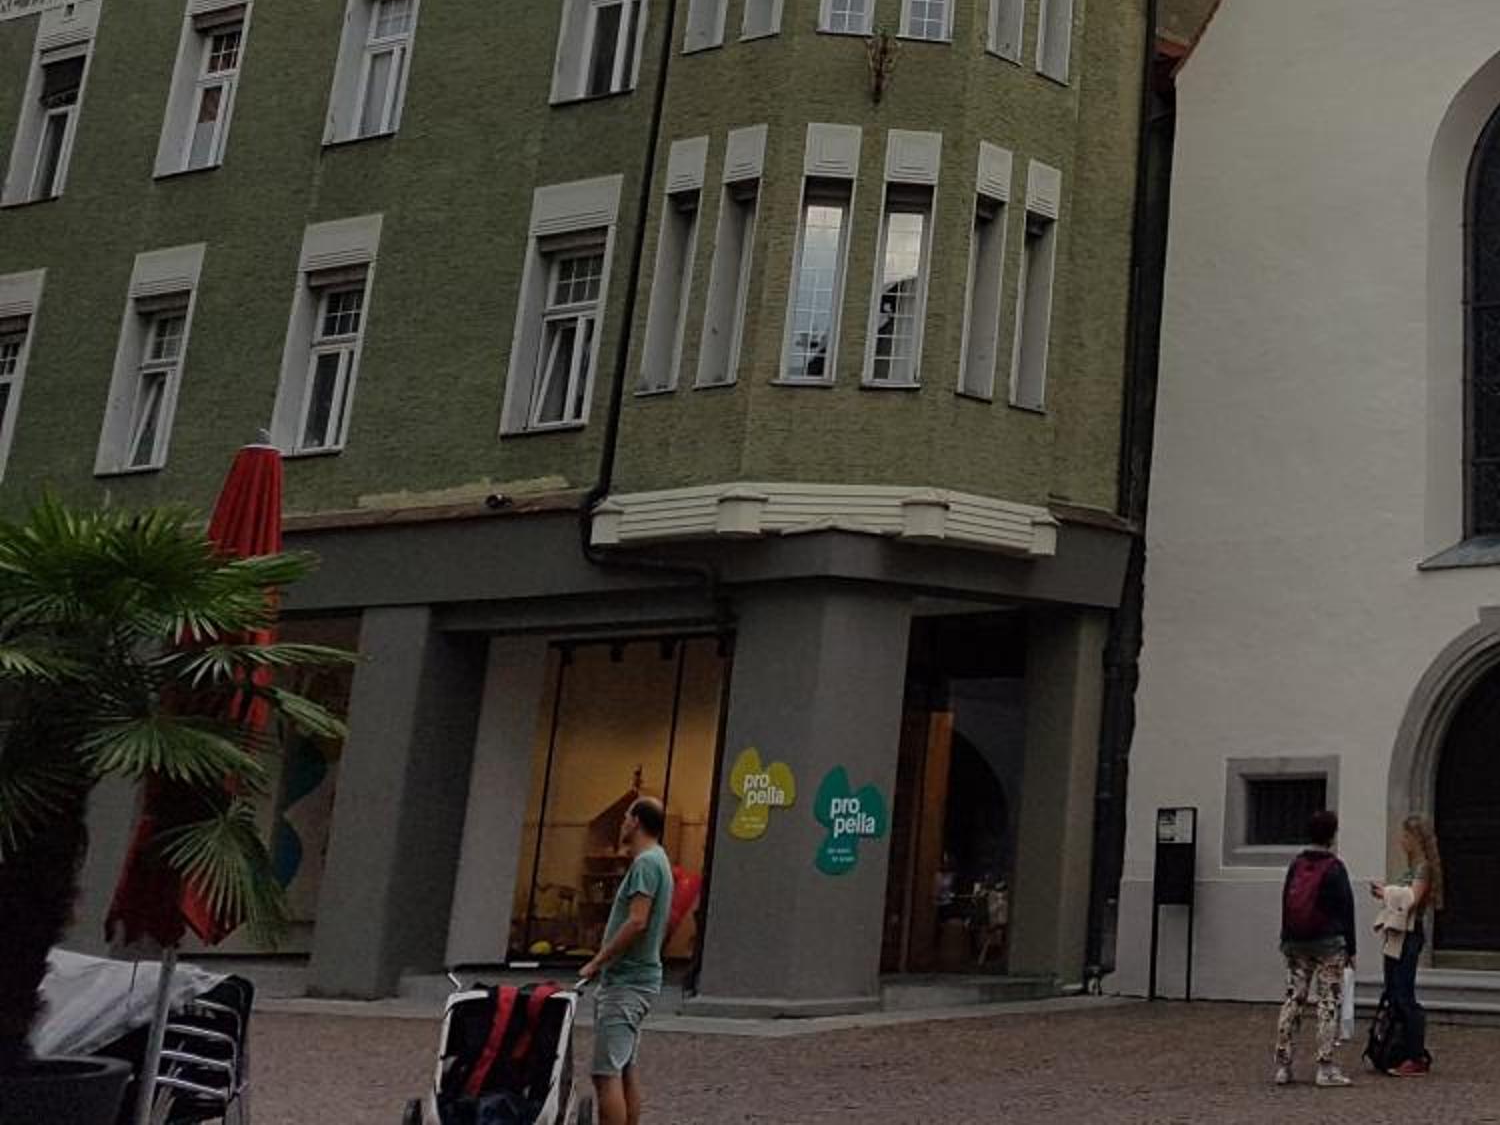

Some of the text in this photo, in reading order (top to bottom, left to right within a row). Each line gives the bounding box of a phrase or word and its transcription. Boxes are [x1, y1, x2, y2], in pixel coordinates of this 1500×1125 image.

[743, 773, 769, 793] pro
[746, 785, 785, 808] pella
[829, 797, 860, 819] pro
[833, 811, 875, 838] pella
